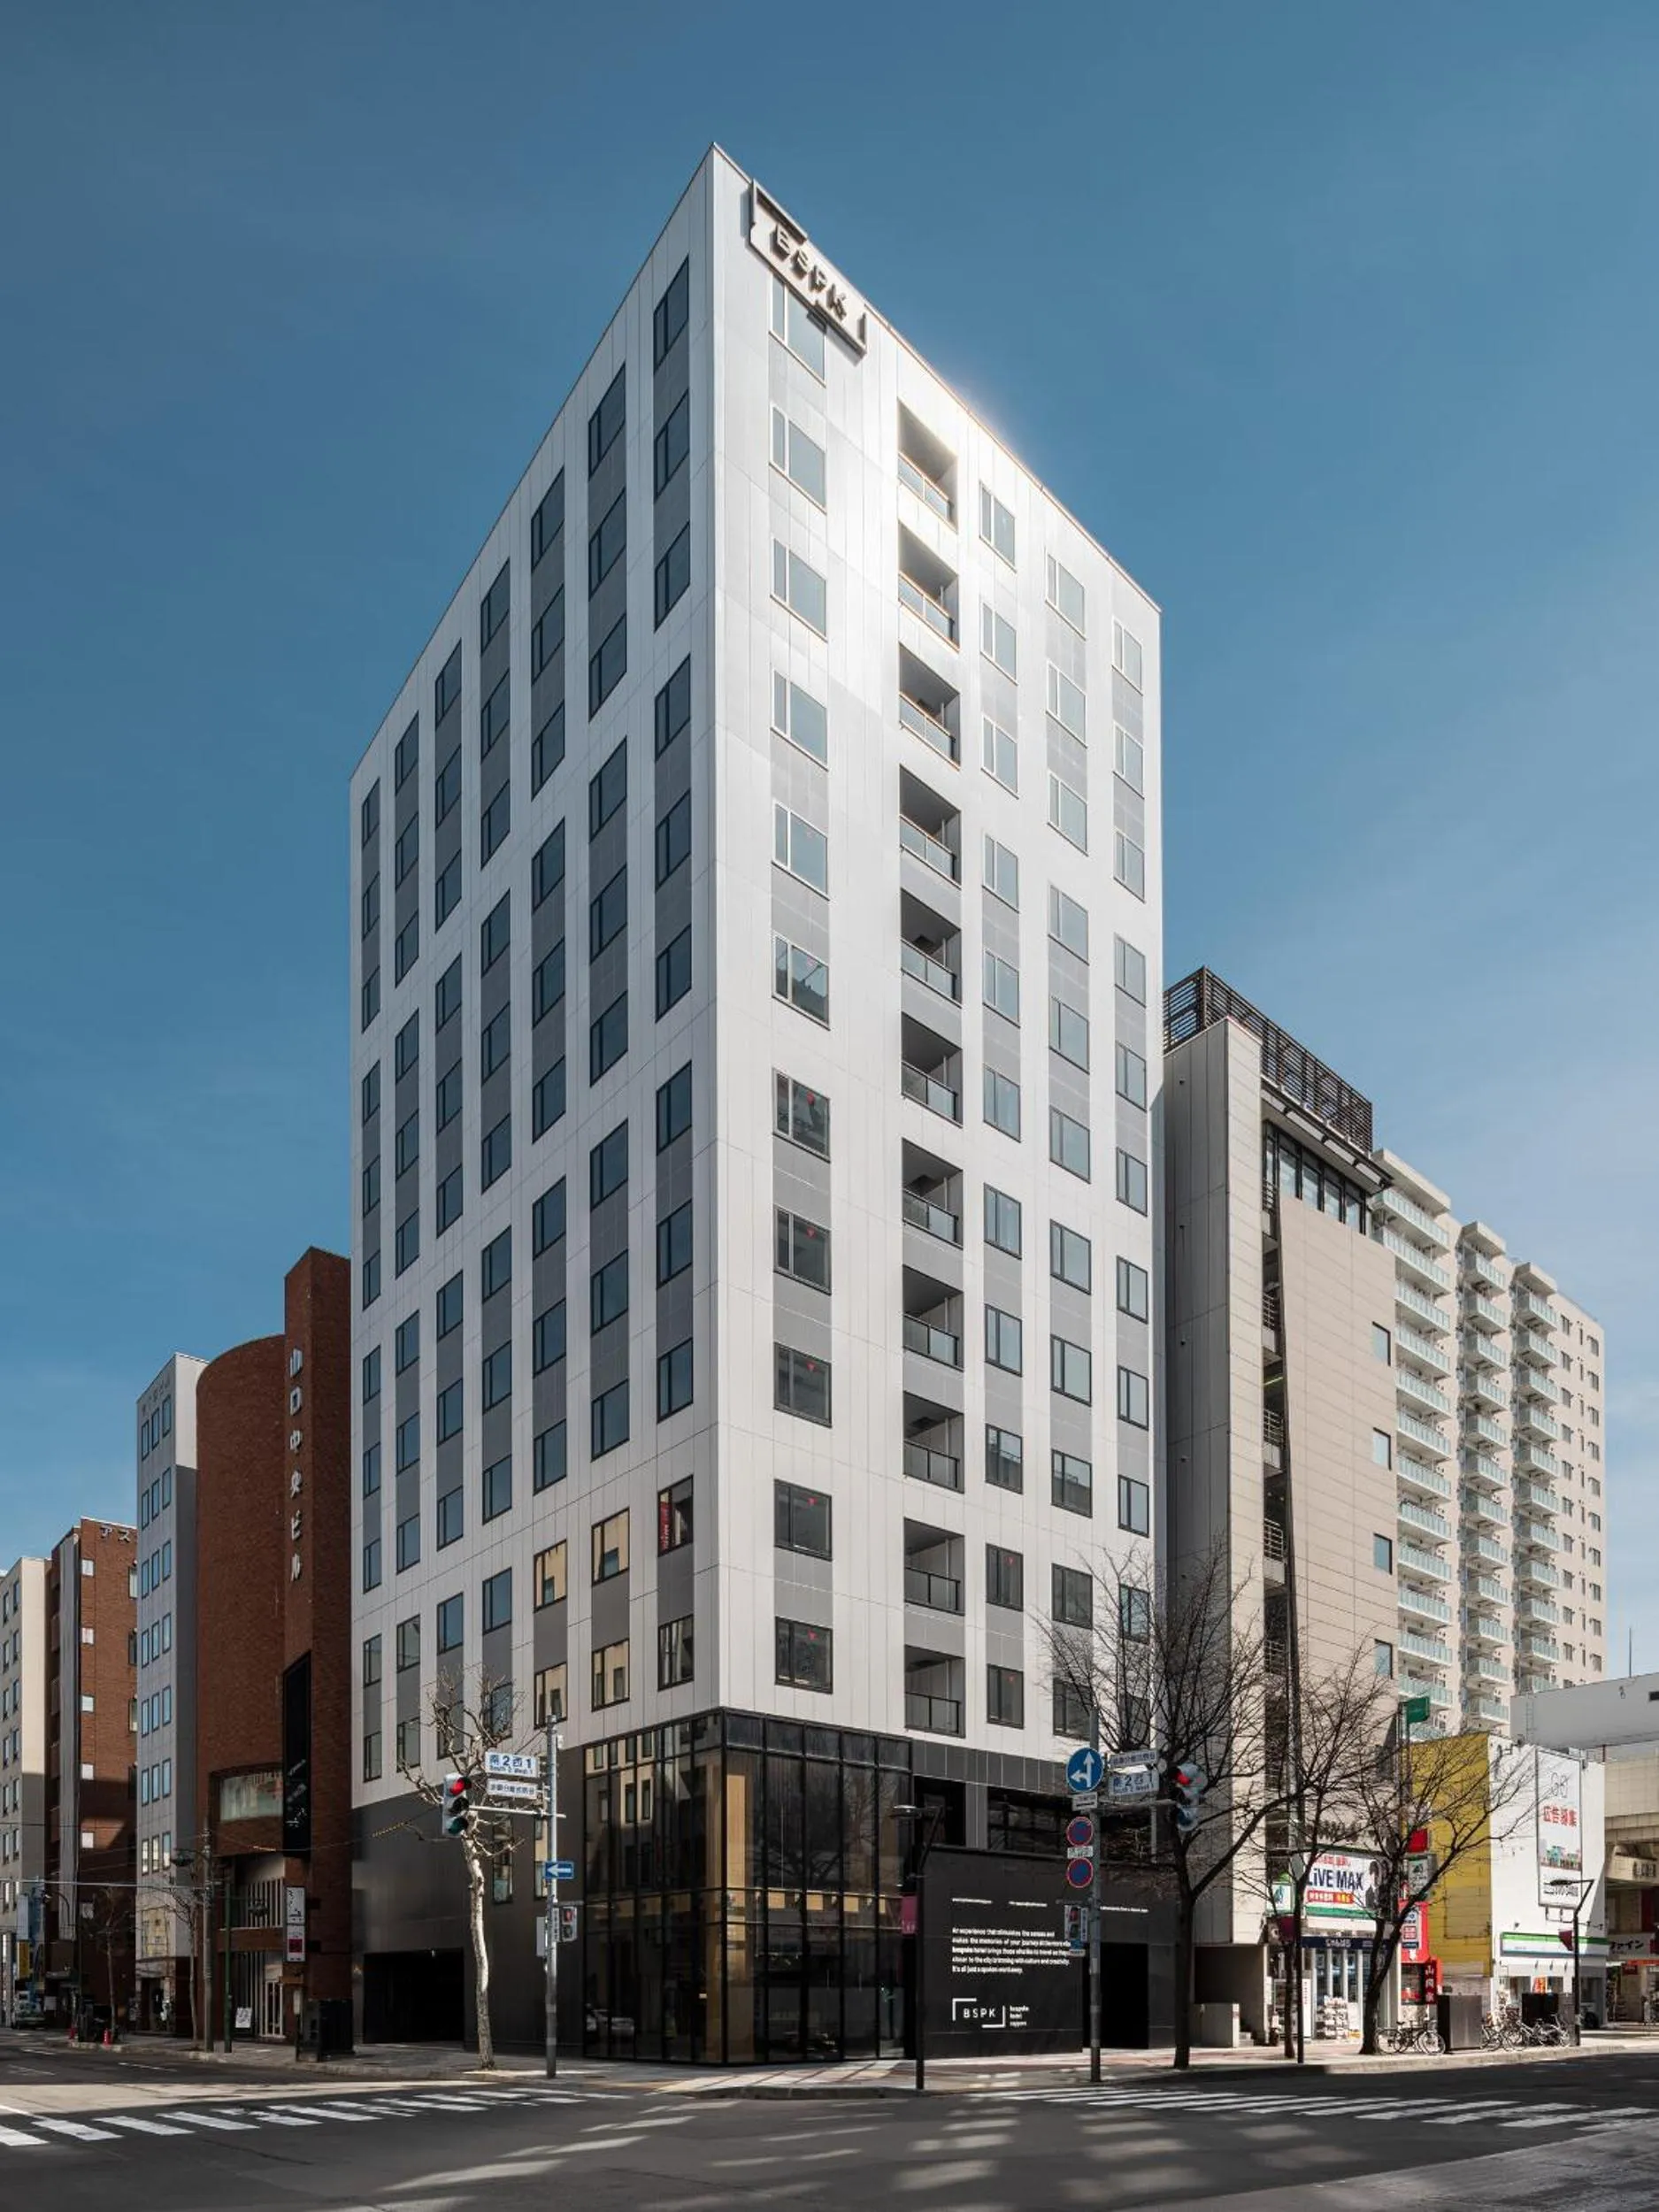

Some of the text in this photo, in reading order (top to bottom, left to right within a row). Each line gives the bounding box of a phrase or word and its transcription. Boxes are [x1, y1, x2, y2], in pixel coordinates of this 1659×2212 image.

[489, 1754, 532, 1769] 南2西1
[1336, 1870, 1364, 1892] MAX
[963, 2008, 996, 2018] BSPK
